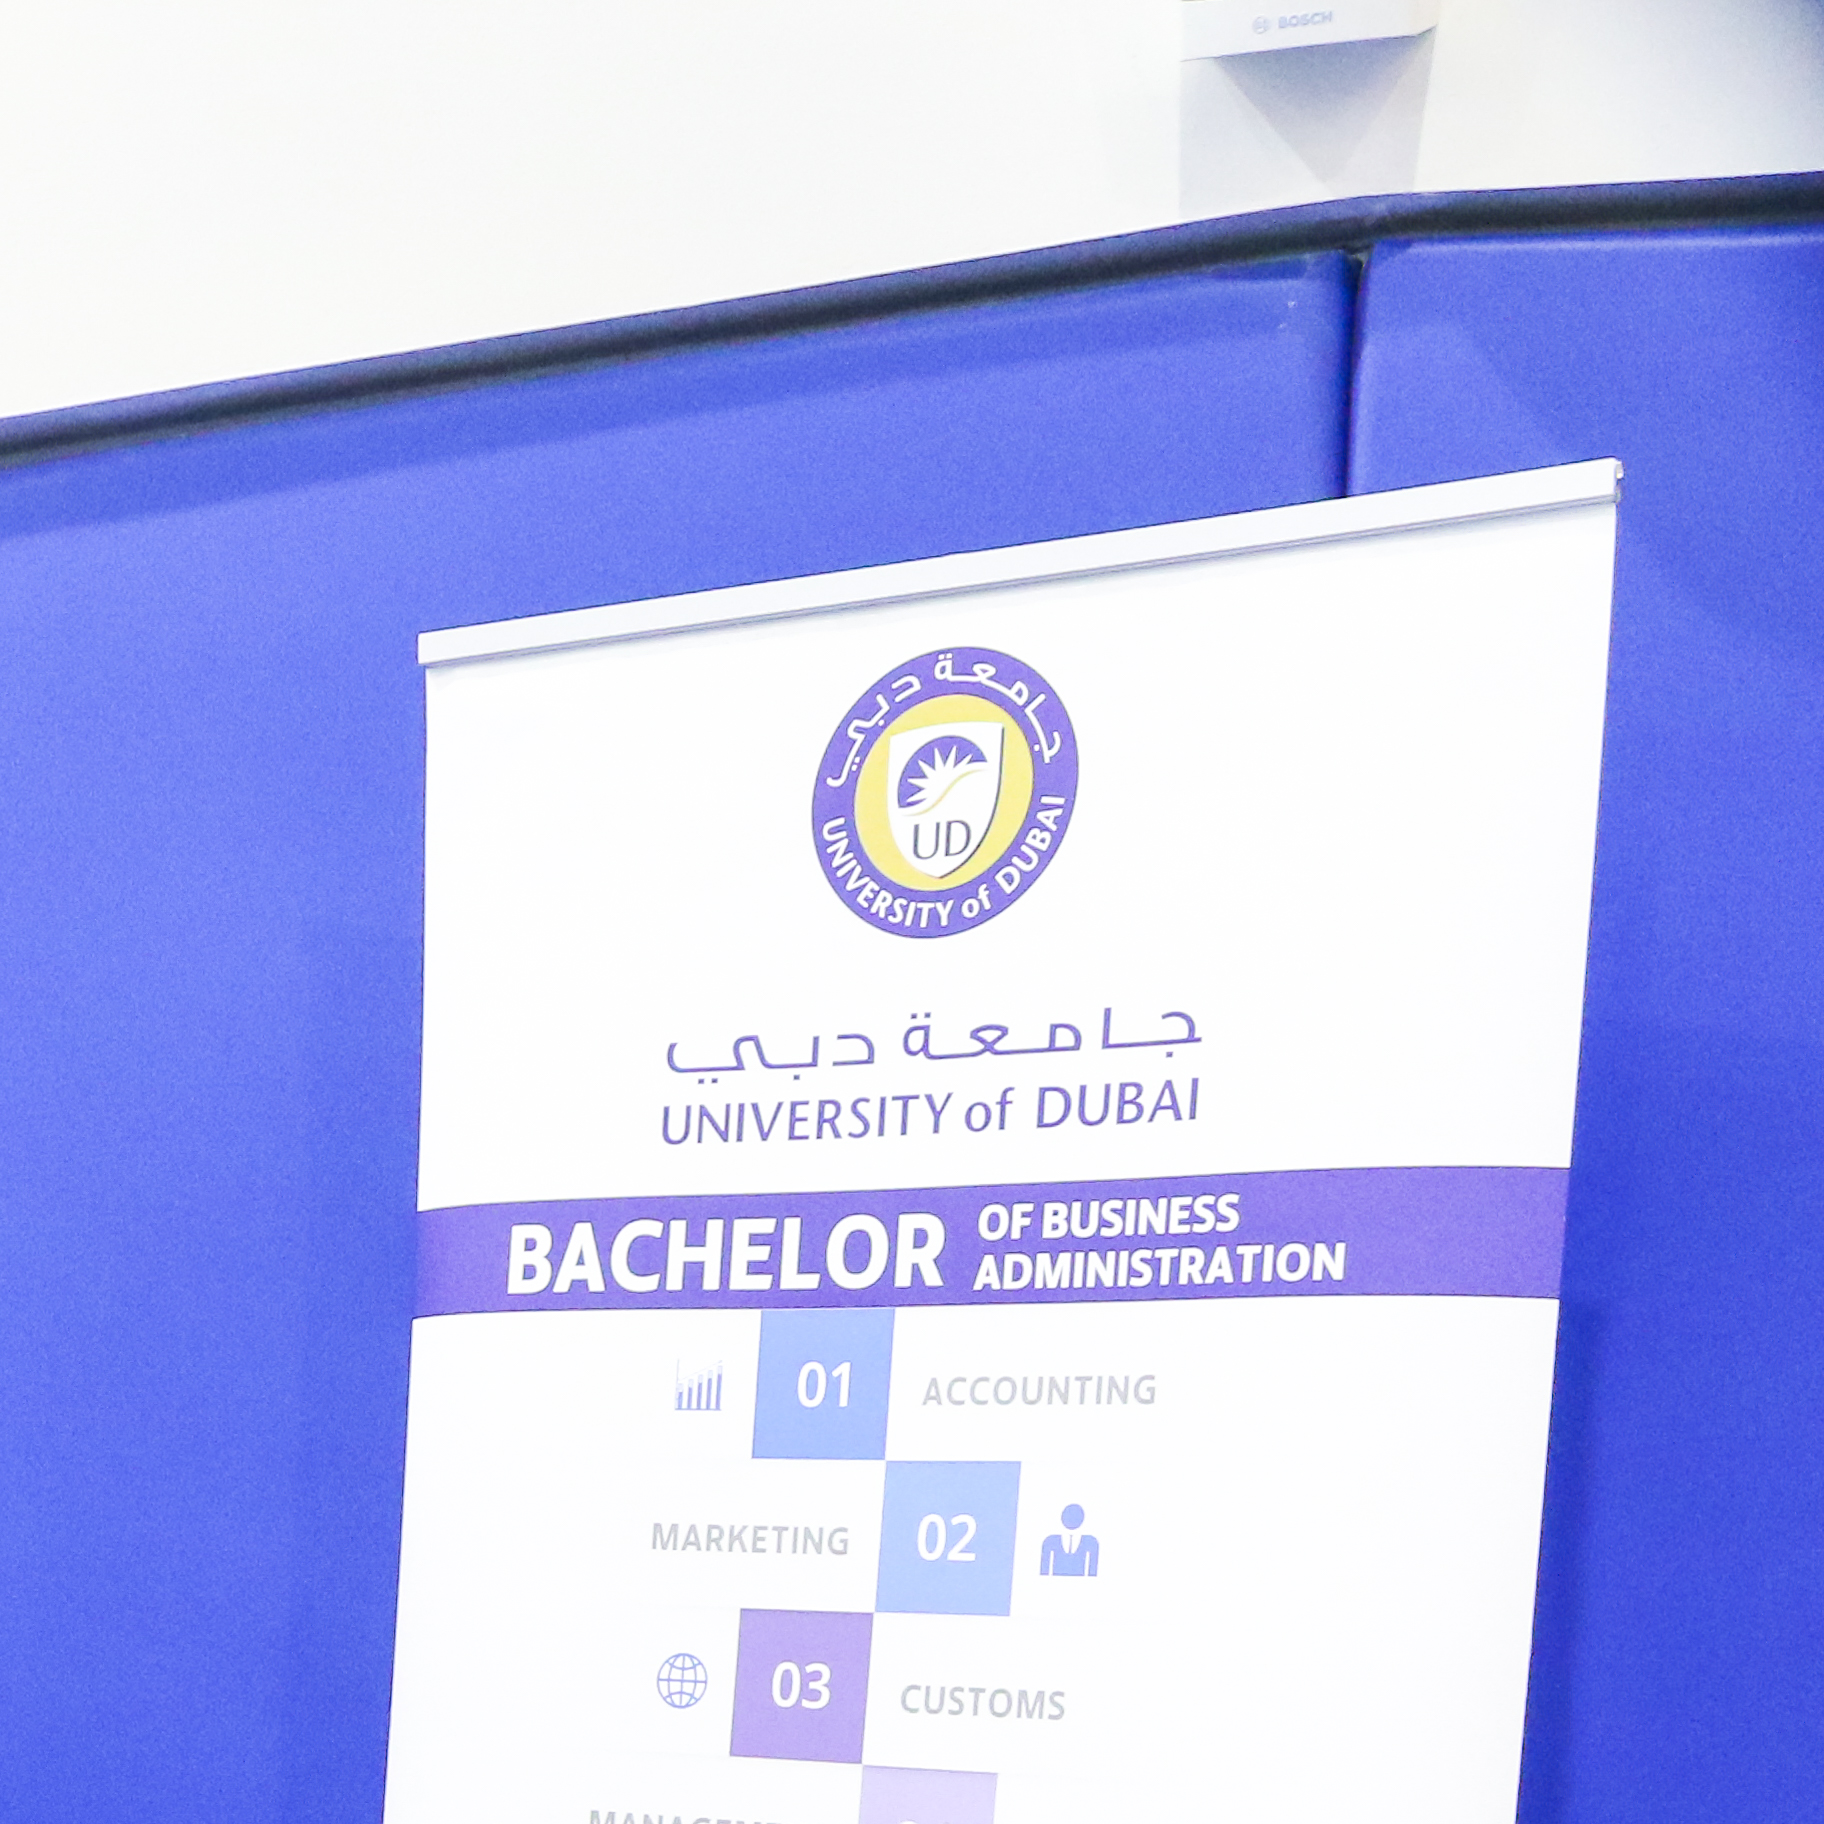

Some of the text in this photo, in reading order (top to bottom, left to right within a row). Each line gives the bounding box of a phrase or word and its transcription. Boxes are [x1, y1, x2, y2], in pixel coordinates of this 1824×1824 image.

[826, 653, 1062, 788] جامعة دبي
[822, 795, 1066, 928] UNIVERSITY of DUBAI
[912, 819, 972, 860] UD
[665, 1005, 1203, 1085] جامعة دبي
[661, 1078, 1199, 1147] UNIVERSITY of DUBAI
[978, 1194, 1240, 1242] OF BUSINESS
[506, 1212, 945, 1295] BACHELOR
[973, 1242, 1345, 1291] ADMINISTRATION
[797, 1361, 853, 1409] 01
[922, 1375, 1157, 1408] ACCOUNTING
[651, 1522, 850, 1556] MARKETING
[916, 1514, 978, 1563] 02
[771, 1661, 831, 1710] 03
[899, 1684, 1066, 1722] CUSTOMS
